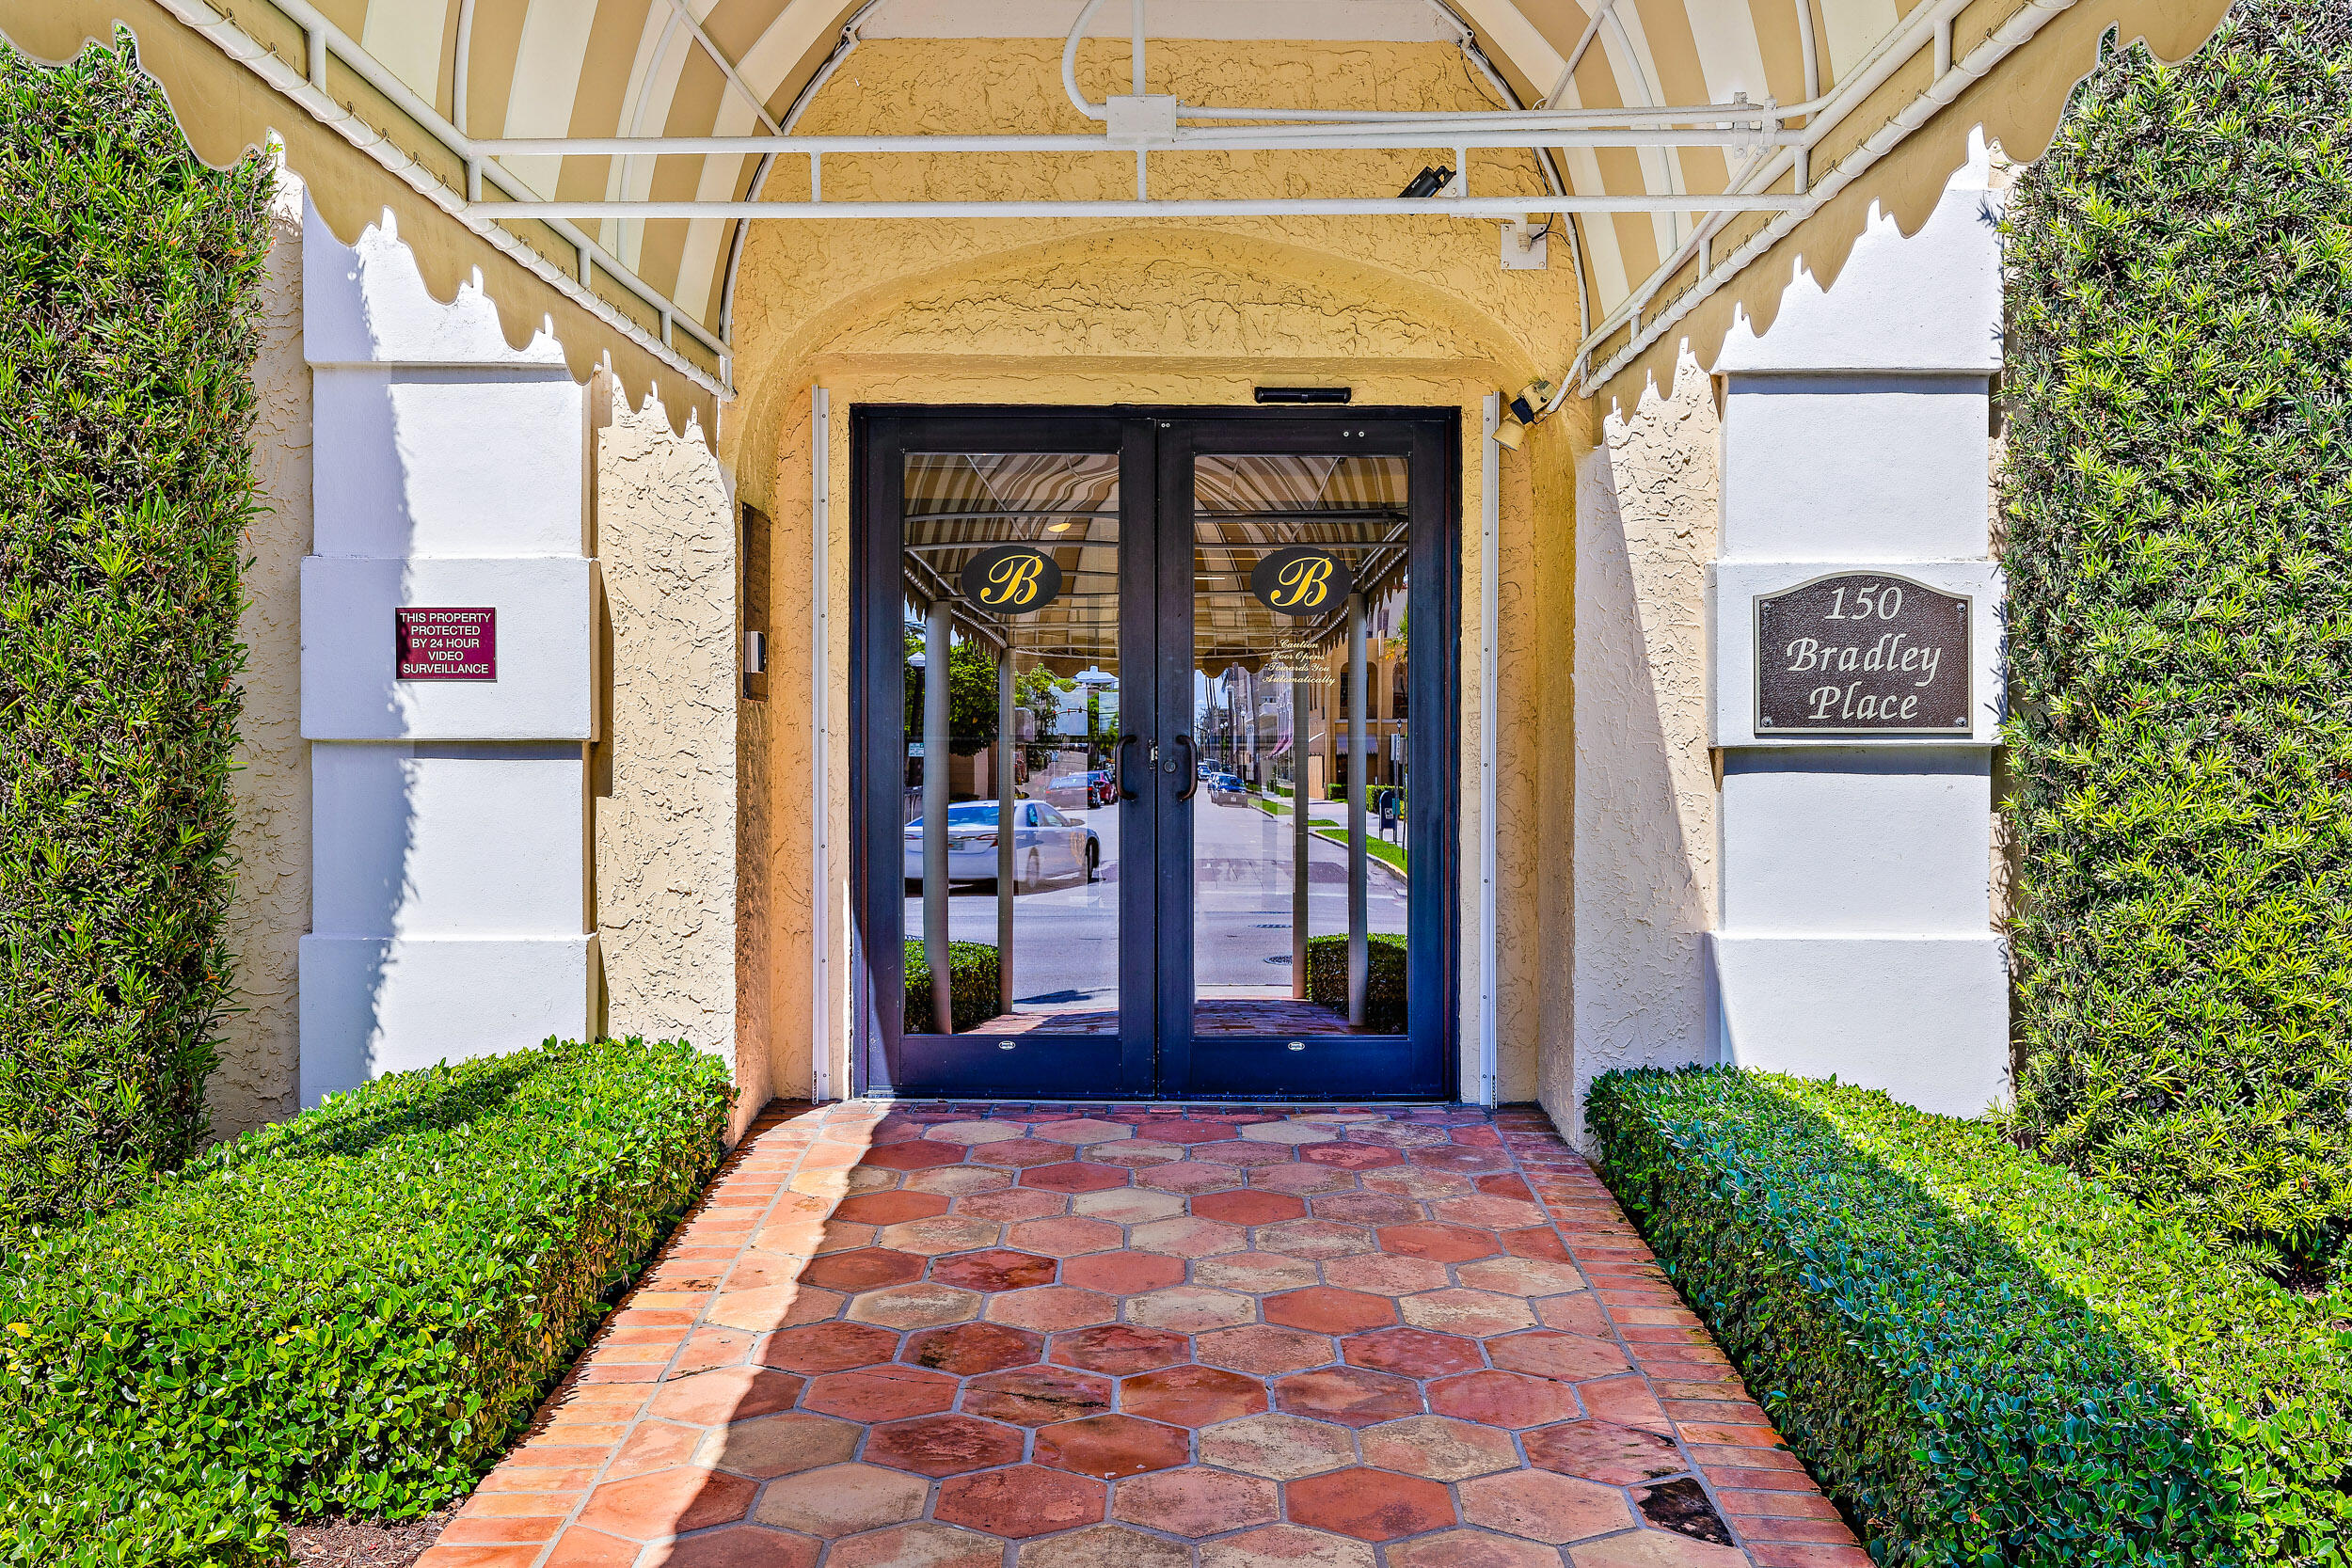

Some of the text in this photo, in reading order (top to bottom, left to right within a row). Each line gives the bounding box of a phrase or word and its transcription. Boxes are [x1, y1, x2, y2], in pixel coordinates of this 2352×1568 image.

[1825, 583, 1903, 621] 150
[400, 612, 491, 623] THIS PROPERTY
[411, 626, 481, 636] PROTECTED
[412, 639, 480, 648] BY 24 HOUR
[1279, 639, 1319, 649] Caution
[428, 651, 464, 661] VIDEO
[1270, 651, 1326, 662] Door Opens
[1787, 633, 1942, 688] Bradley
[403, 664, 489, 673] SURVEILLANCE
[1267, 662, 1330, 673] Towards You
[1262, 674, 1336, 687] Automatically
[1808, 681, 1919, 721] Place
